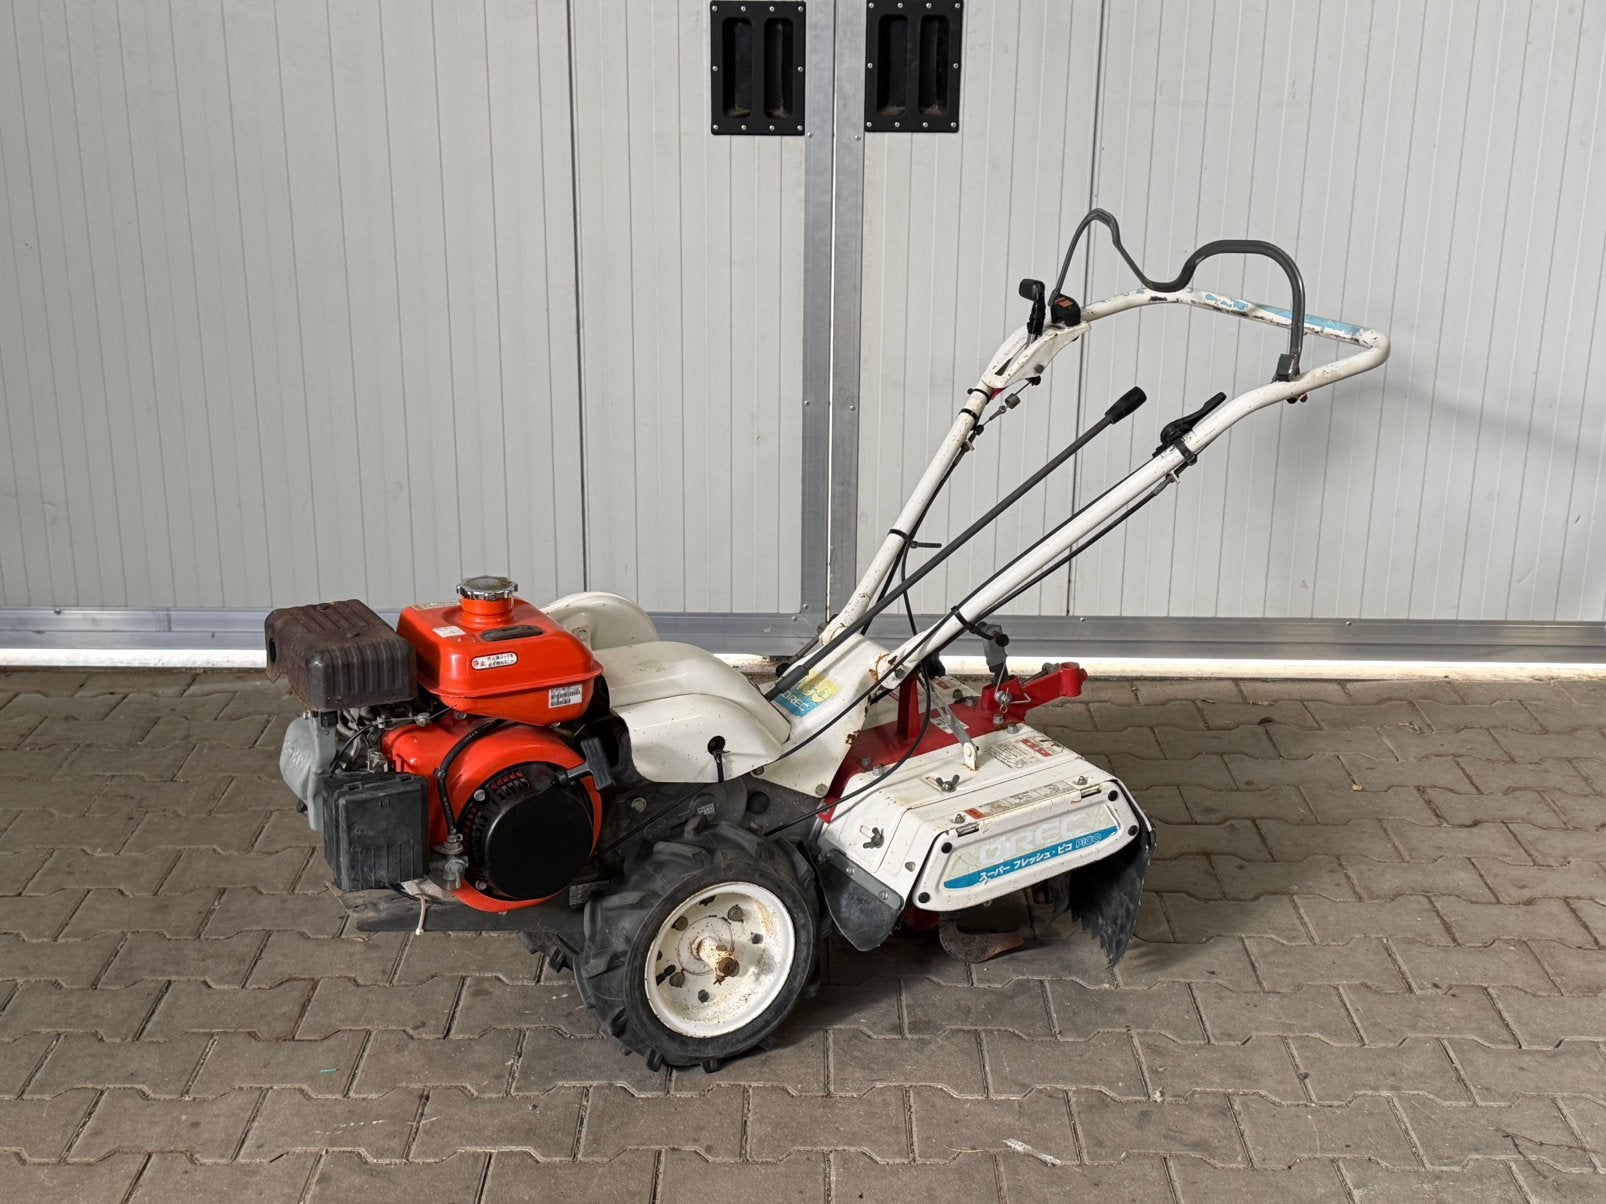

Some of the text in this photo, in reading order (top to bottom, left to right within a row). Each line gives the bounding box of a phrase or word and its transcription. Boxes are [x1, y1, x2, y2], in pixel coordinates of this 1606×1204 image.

[780, 690, 809, 711] OREC
[978, 811, 1092, 863] OREC
[979, 866, 1011, 883] スーパー
